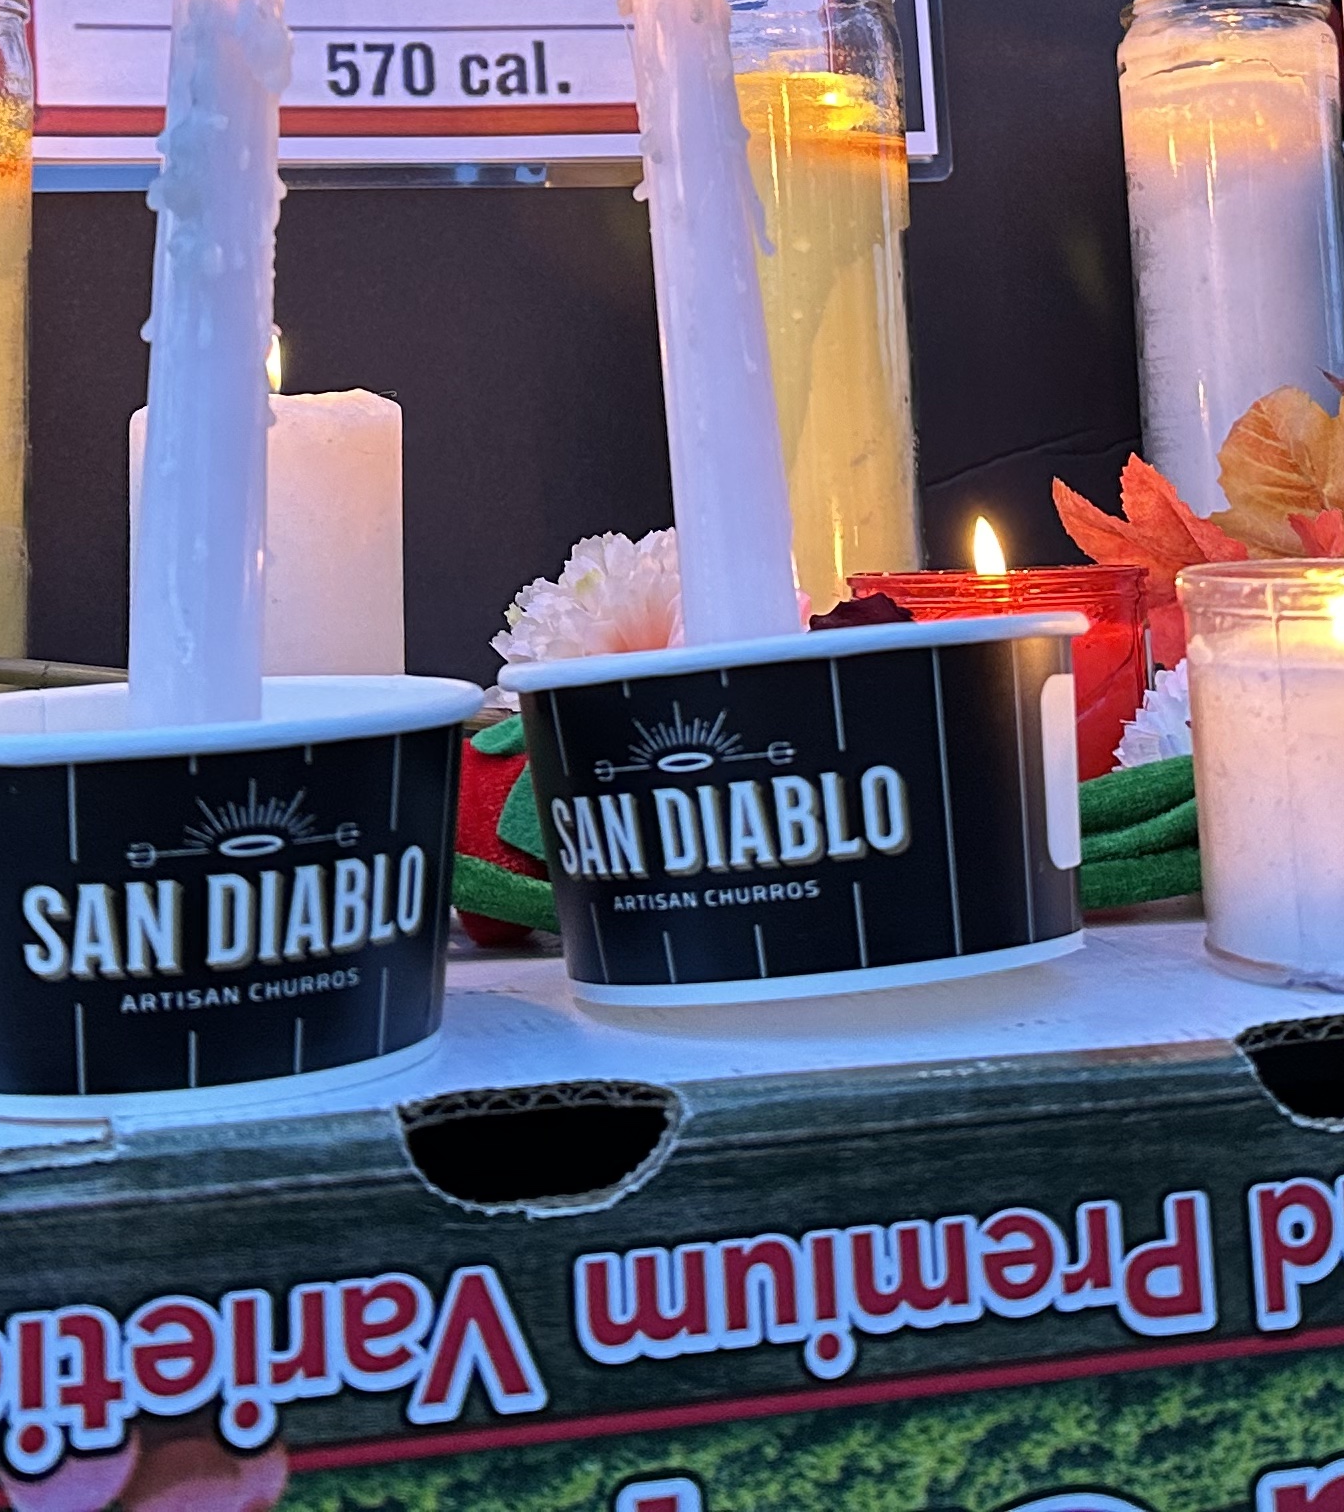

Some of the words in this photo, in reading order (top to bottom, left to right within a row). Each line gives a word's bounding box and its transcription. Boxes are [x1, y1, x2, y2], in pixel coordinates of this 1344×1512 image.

[327, 43, 435, 97] 570
[460, 41, 571, 95] cal.
[551, 793, 649, 881] SAN
[653, 765, 912, 878] DIABLO
[22, 880, 184, 981] SAN
[205, 845, 426, 971] DIABLO
[613, 891, 698, 913] ARTISAN
[704, 880, 822, 907] CHURROS
[120, 986, 242, 1015] ARTISAN
[248, 967, 364, 1003] CHURROS
[574, 1191, 1217, 1379] Premium
